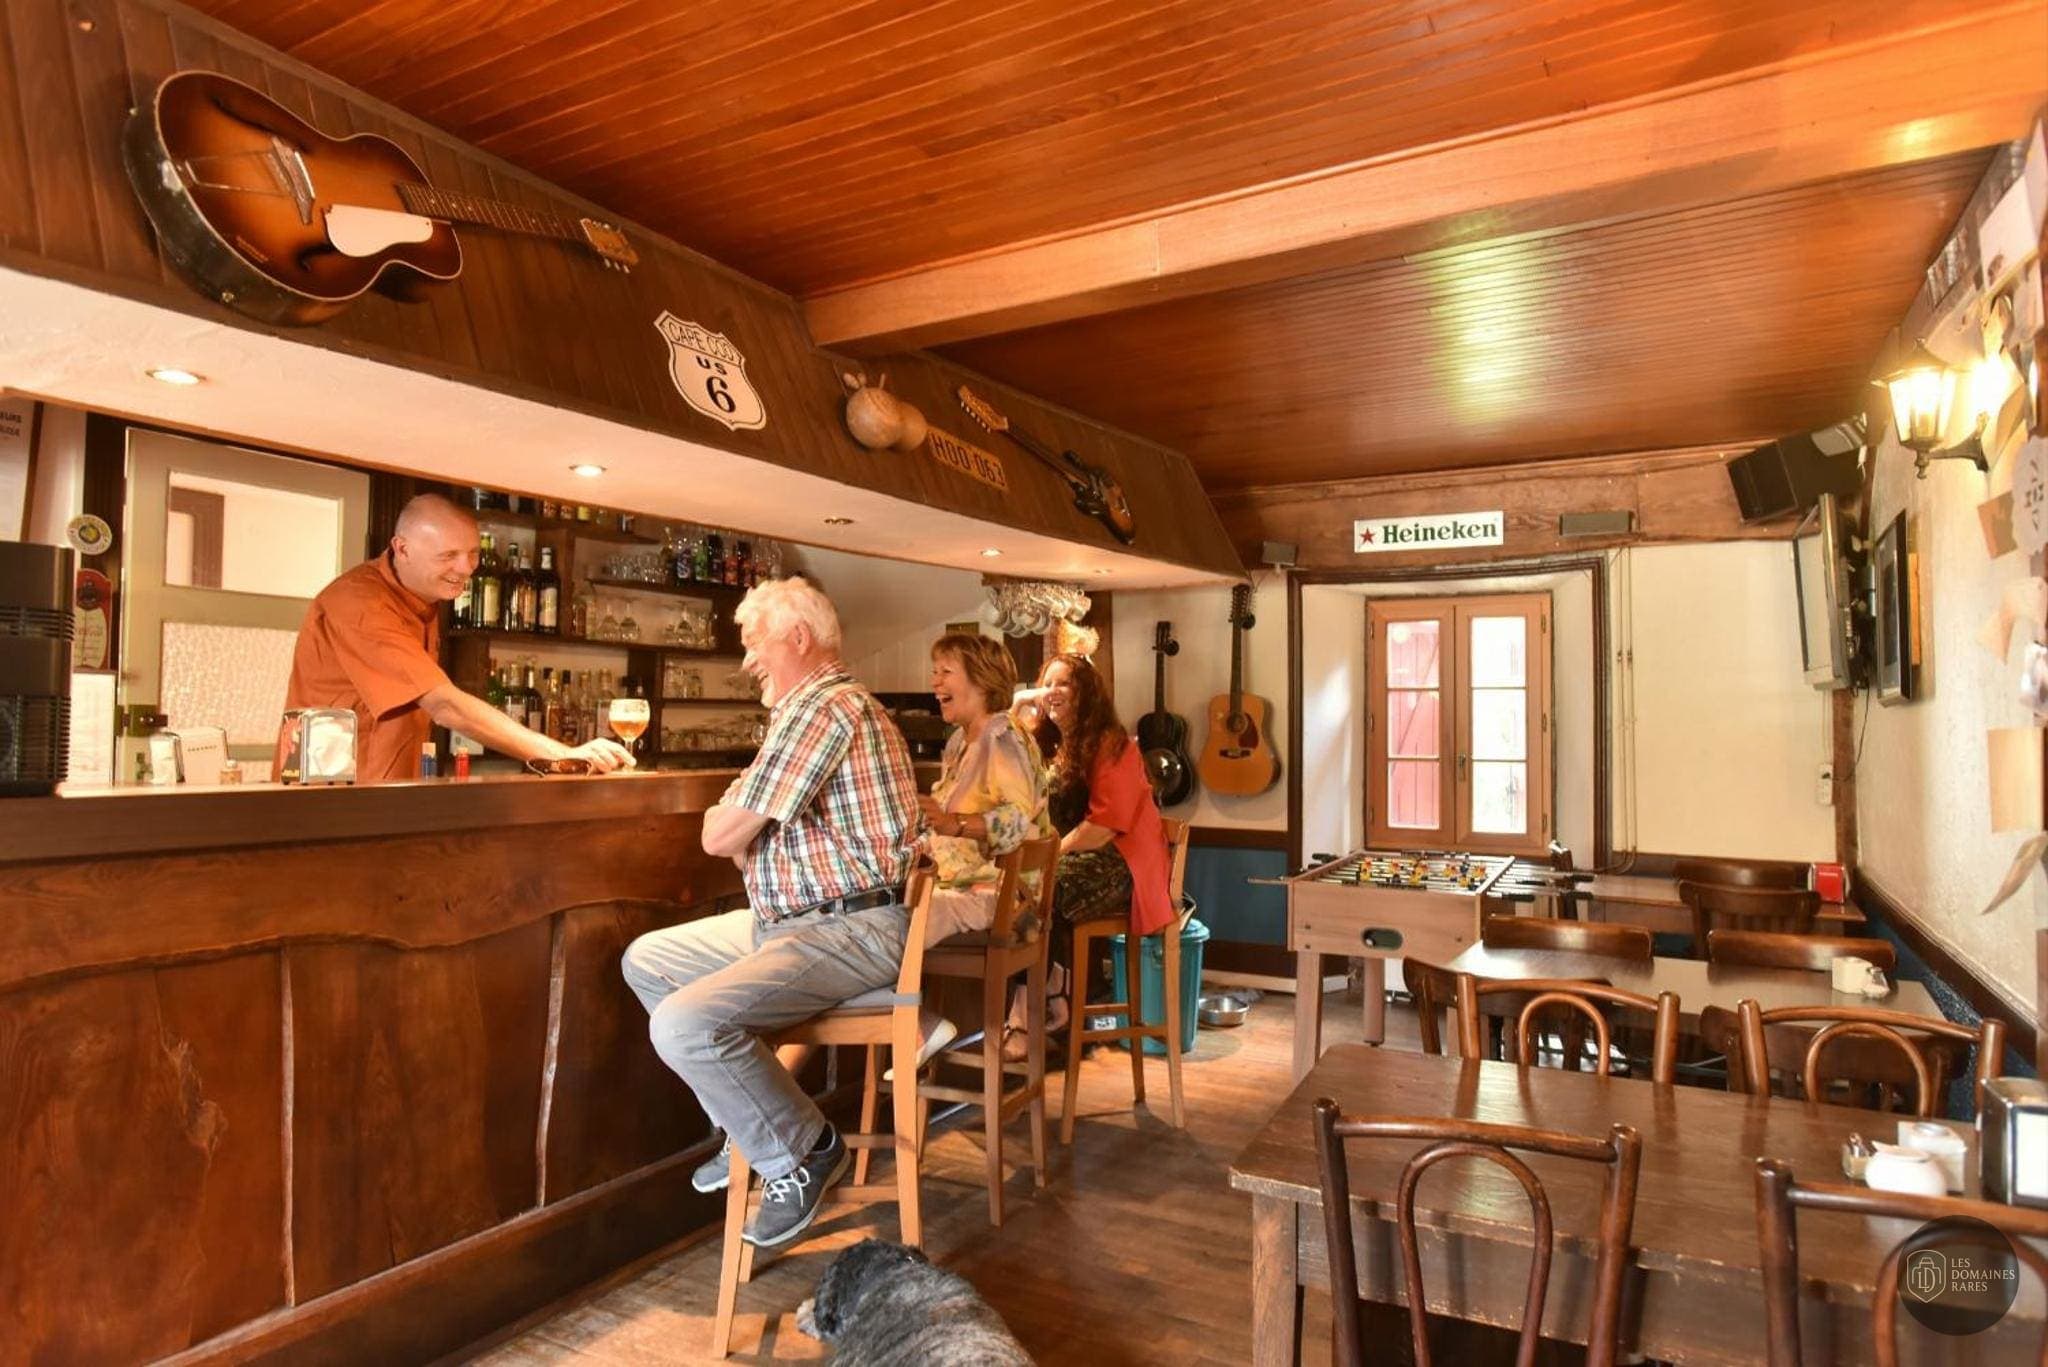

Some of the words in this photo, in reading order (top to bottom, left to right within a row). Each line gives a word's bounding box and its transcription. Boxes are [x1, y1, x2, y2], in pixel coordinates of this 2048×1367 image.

[668, 322, 706, 351] CAPE
[696, 355, 727, 375] US
[706, 376, 736, 413] 6
[1382, 521, 1497, 544] Heineken
